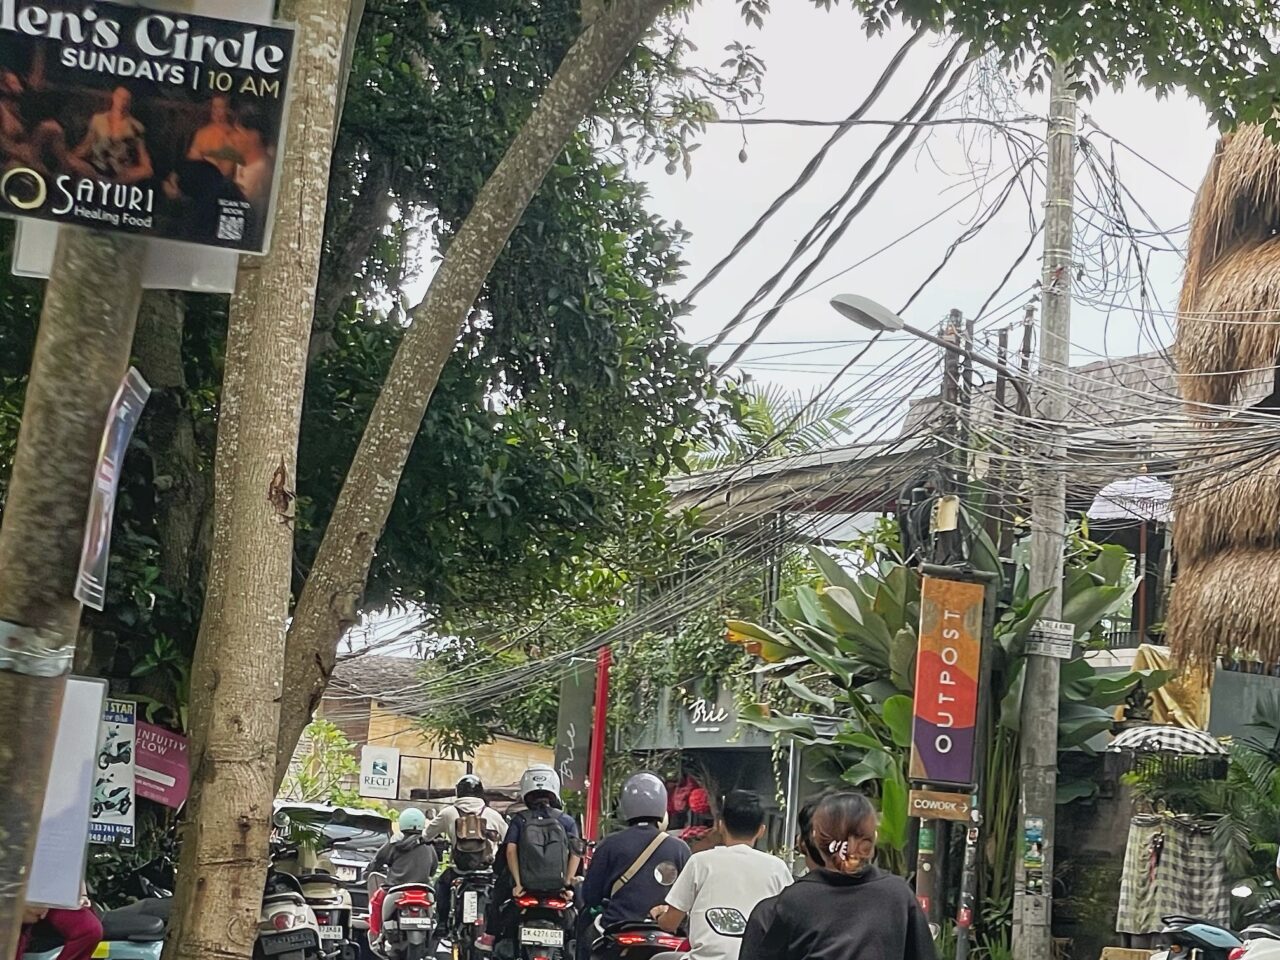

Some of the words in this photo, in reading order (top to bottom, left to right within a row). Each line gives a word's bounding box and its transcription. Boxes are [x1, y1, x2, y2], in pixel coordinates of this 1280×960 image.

[135, 14, 285, 74] Circle
[61, 48, 185, 85] SUNDAYS
[208, 70, 232, 92] 10
[239, 76, 280, 98] AM
[52, 175, 154, 215] SAYURI
[122, 212, 153, 229] Food
[935, 610, 960, 754] OUTPOST
[111, 702, 134, 714] STAR
[688, 696, 728, 724] Brie
[135, 738, 168, 755] FLOW
[913, 799, 957, 812] COWORK
